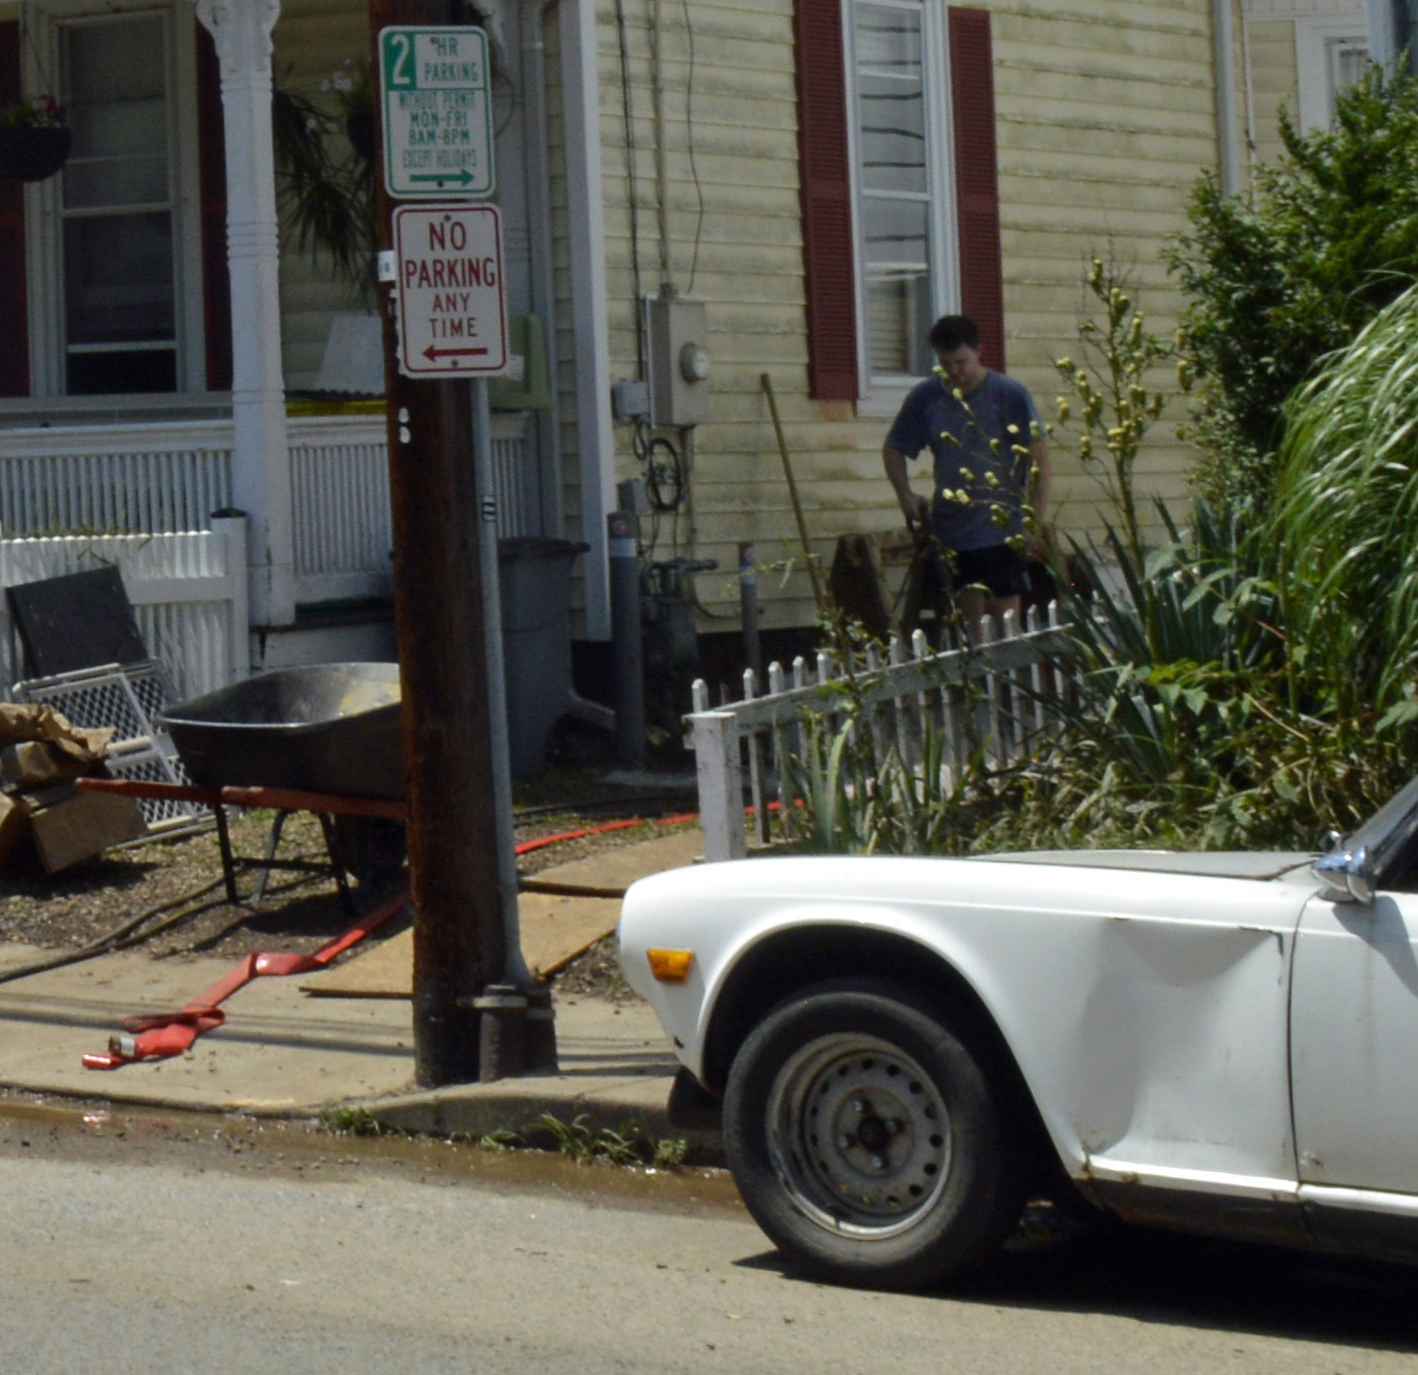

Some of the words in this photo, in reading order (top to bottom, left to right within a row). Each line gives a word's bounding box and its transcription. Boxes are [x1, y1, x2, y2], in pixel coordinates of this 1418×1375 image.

[391, 34, 410, 84] 2
[436, 36, 459, 57] HR
[424, 61, 478, 82] PARKING
[400, 90, 437, 110] WITHOUT
[410, 110, 468, 128] MON-FRI
[408, 127, 470, 146] 8AM-8PM
[403, 149, 432, 168] EXCEPT
[436, 148, 477, 168] HOLIDAYS
[428, 221, 467, 252] NO
[405, 256, 496, 289] PARKING
[432, 291, 471, 313] ANY
[428, 316, 478, 338] TIME
